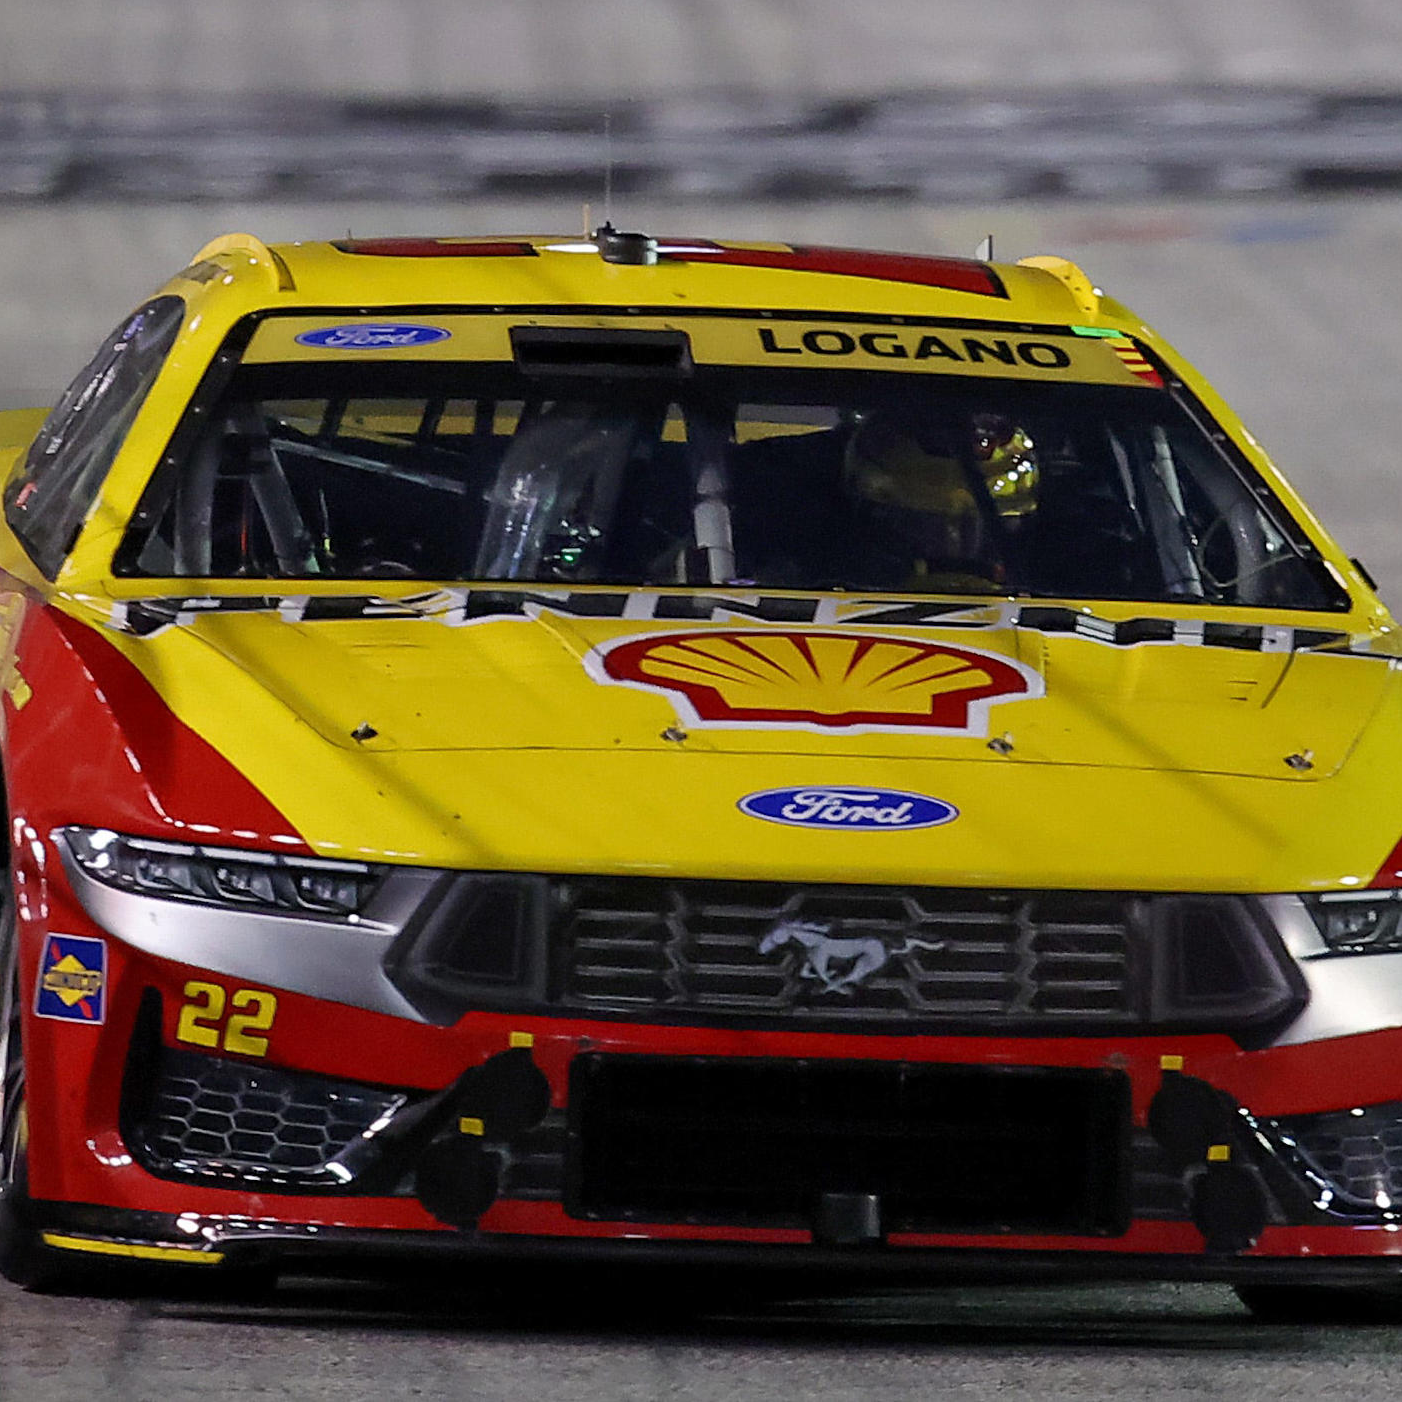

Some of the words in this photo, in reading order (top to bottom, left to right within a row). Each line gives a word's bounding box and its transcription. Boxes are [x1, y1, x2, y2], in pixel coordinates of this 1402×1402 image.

[322, 325, 421, 346] Ford
[757, 327, 1072, 369] LOGANO
[779, 788, 916, 826] Ford
[176, 980, 278, 1058] 22
